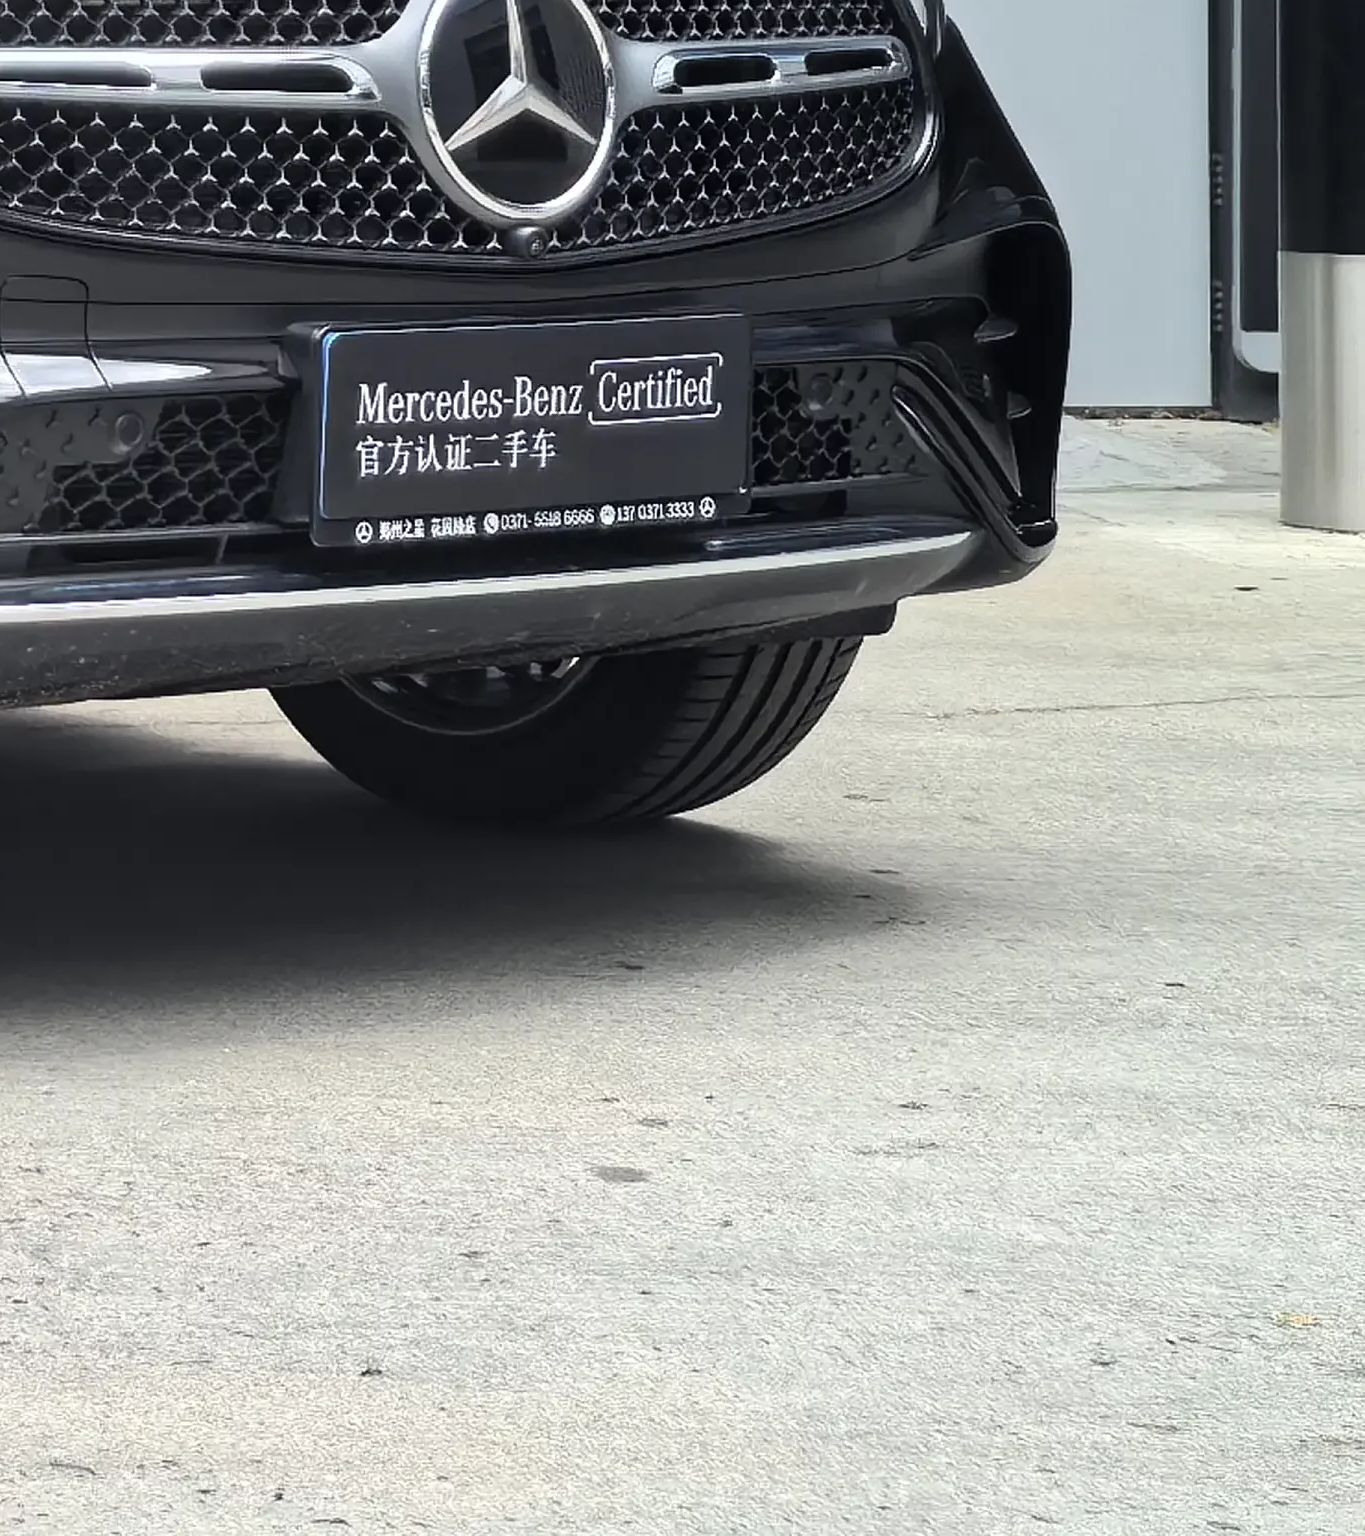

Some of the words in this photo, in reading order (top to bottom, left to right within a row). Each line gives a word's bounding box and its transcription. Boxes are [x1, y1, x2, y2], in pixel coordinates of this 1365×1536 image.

[356, 375, 584, 425] Mercedes-Benz
[597, 365, 713, 413] Certified
[355, 427, 557, 478] 官方认证二手车
